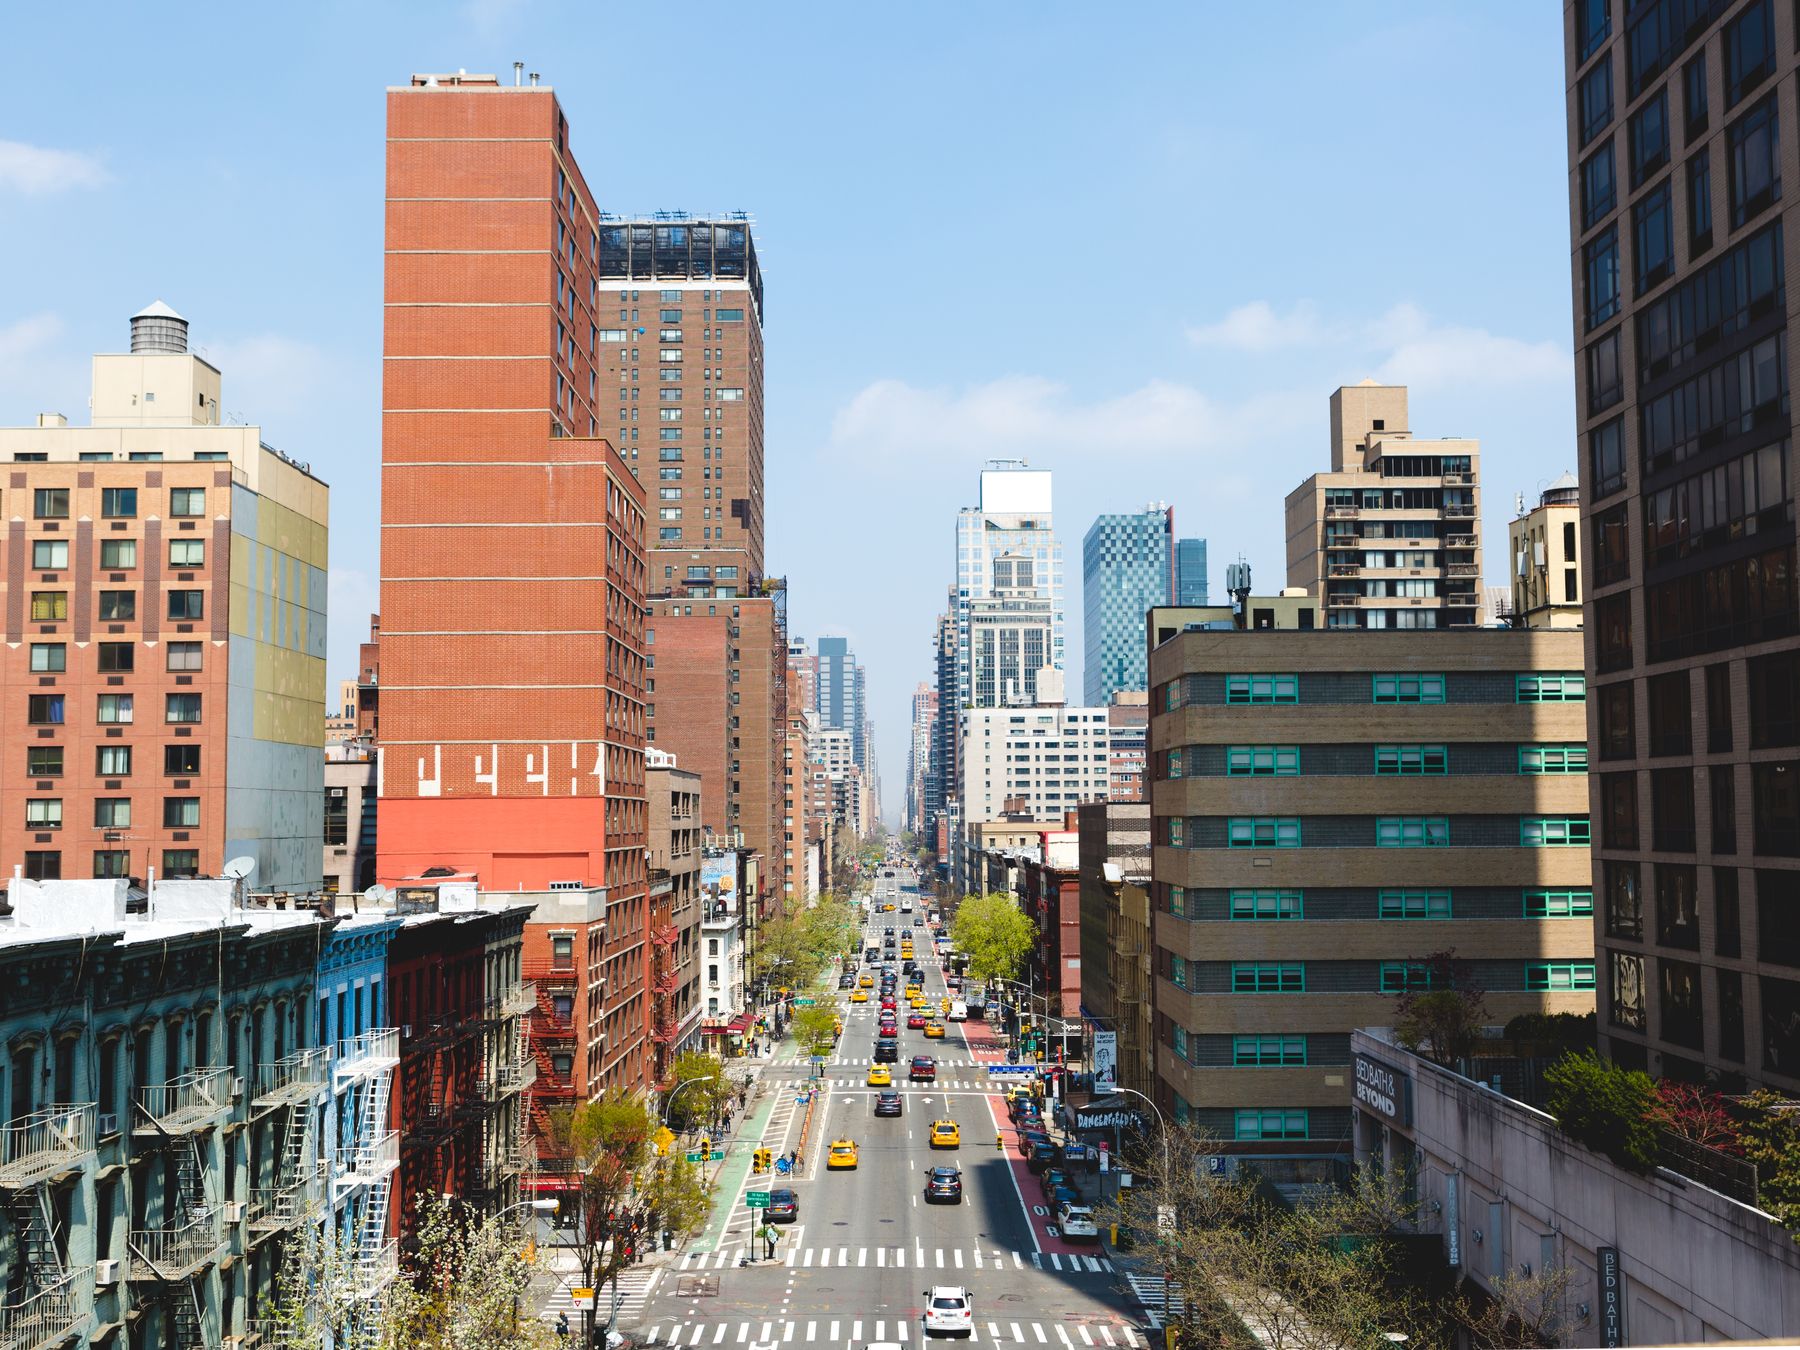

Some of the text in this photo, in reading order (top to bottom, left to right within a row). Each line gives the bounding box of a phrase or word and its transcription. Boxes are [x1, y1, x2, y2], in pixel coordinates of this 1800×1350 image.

[1356, 1058, 1395, 1097] BED BATH &
[1356, 1081, 1396, 1117] BEYOND
[1605, 1253, 1616, 1287] BED
[1606, 1292, 1617, 1338] BATH
